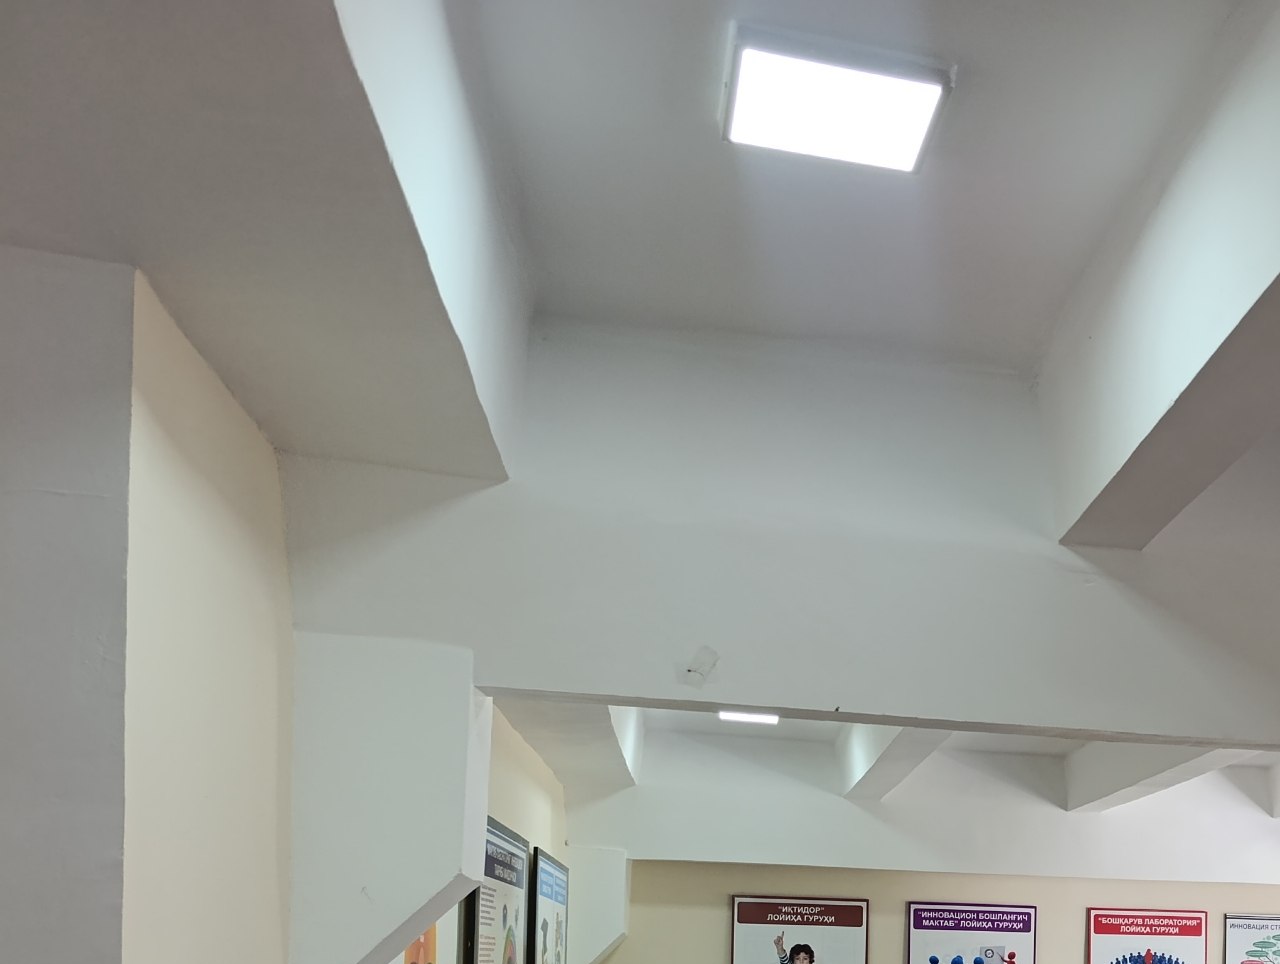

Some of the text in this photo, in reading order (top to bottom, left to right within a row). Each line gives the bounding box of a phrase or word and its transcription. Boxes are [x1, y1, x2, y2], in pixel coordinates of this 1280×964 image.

[767, 914, 834, 923] ЛОЙИҲА ГУРУҲИ
[960, 920, 992, 928] ЛОЙИҲА
